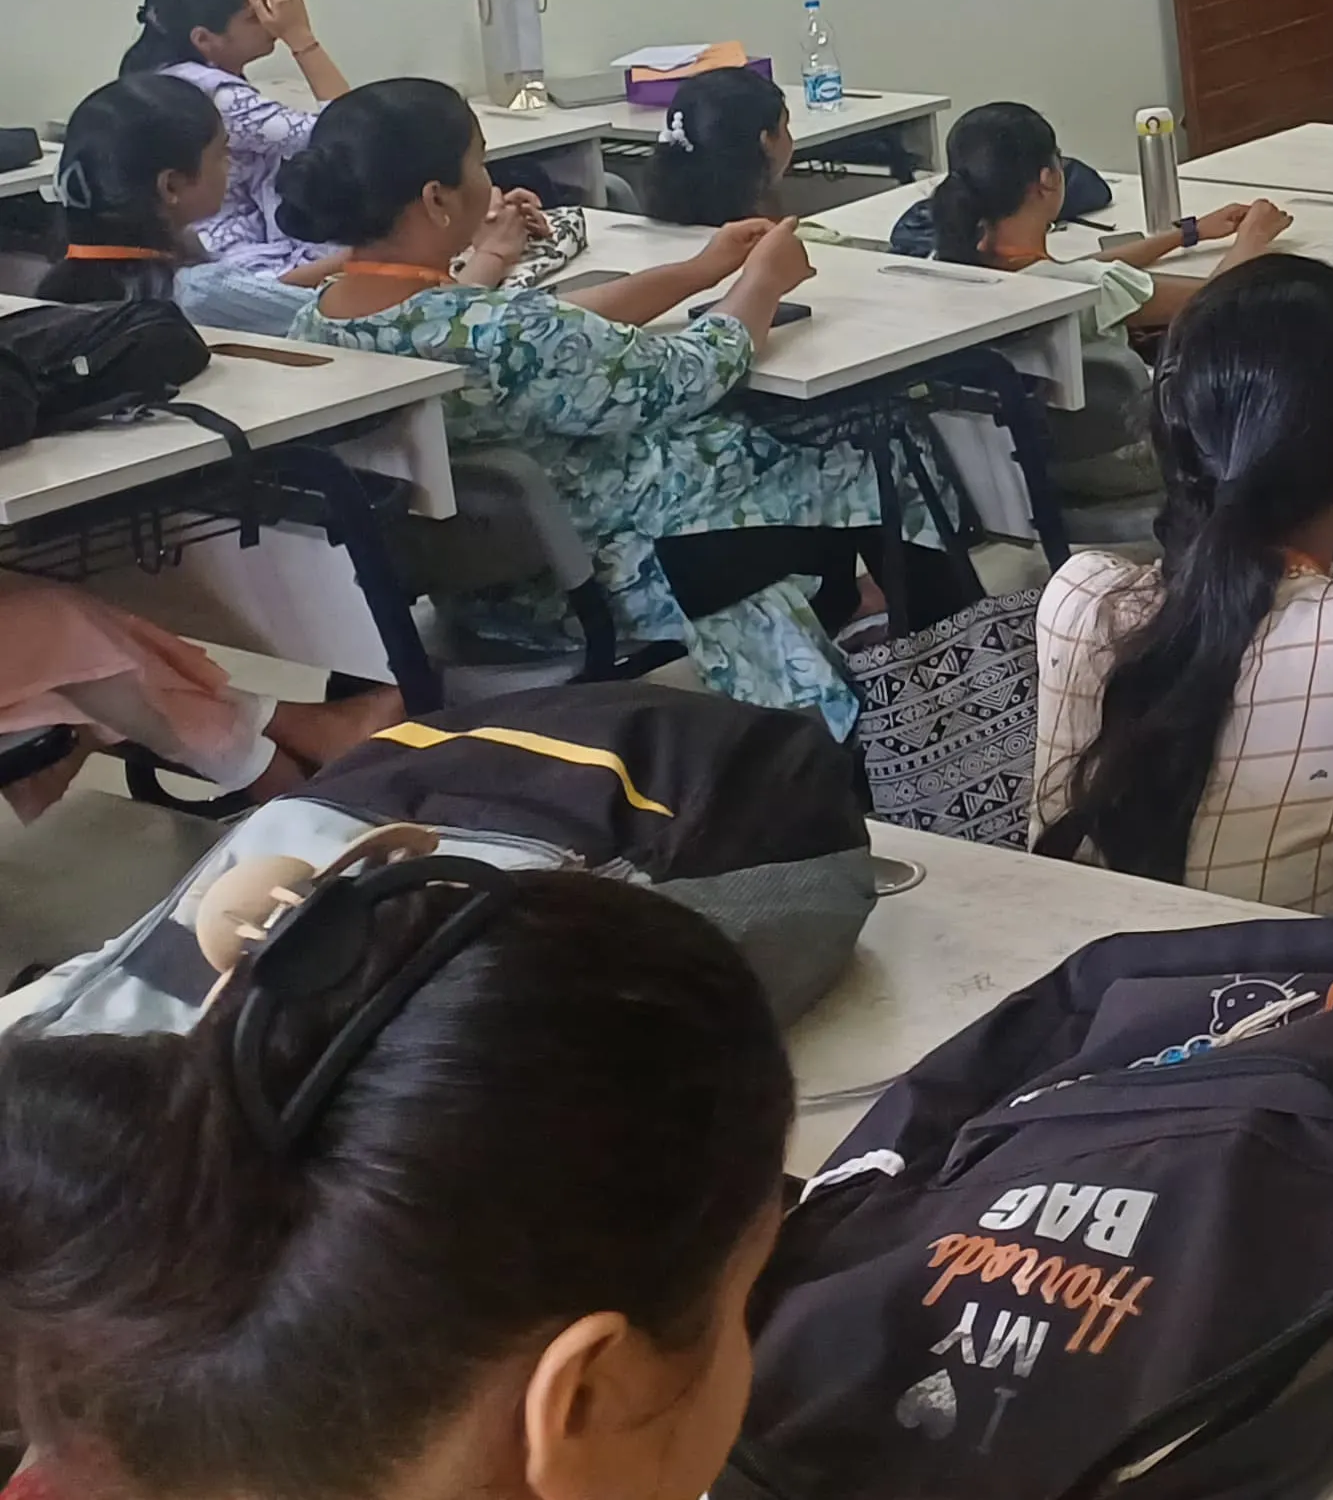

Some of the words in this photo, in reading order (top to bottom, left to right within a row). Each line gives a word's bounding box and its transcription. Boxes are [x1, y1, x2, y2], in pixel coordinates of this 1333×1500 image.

[978, 1182, 1158, 1258] BAG
[922, 1233, 1155, 1355] Harrods
[930, 1301, 1050, 1378] MY
